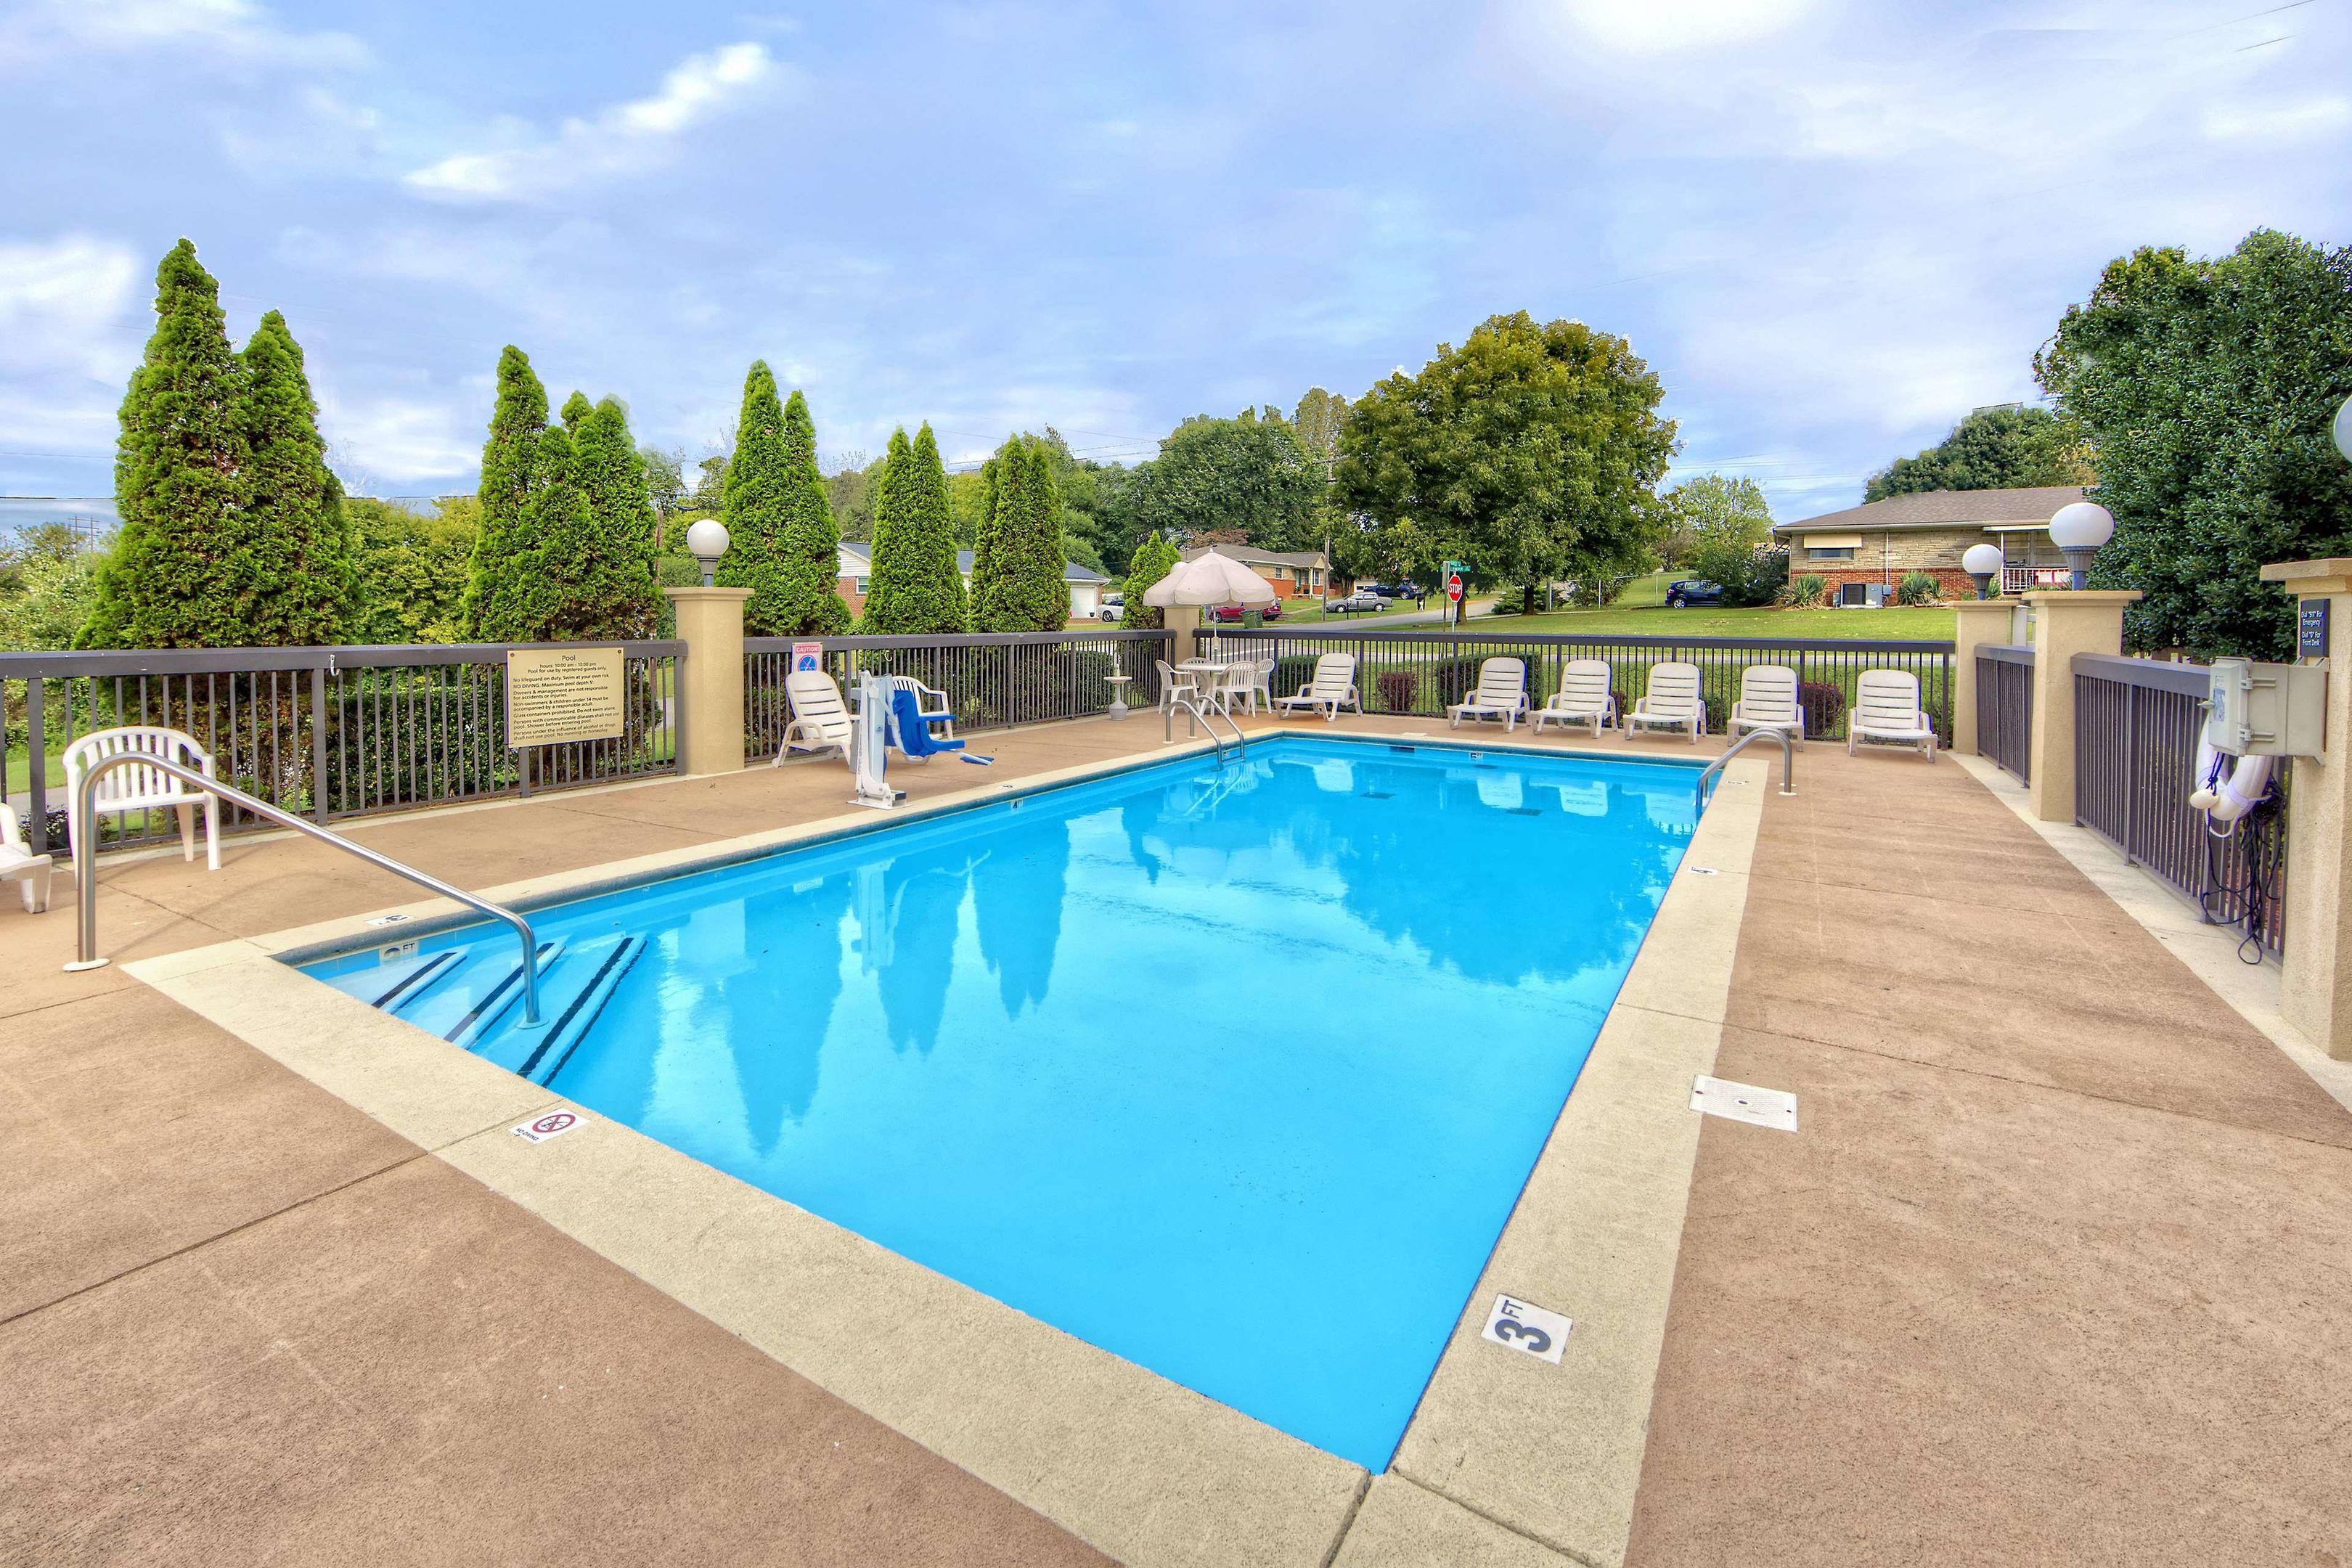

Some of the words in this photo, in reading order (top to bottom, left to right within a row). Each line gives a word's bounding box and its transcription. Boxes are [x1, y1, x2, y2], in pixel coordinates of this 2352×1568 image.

[1449, 584, 1461, 594] STOP
[2303, 618, 2321, 627] Emergency
[522, 1131, 539, 1140] DIVING
[1501, 1299, 1523, 1318] FT
[1495, 1319, 1551, 1352] 3
